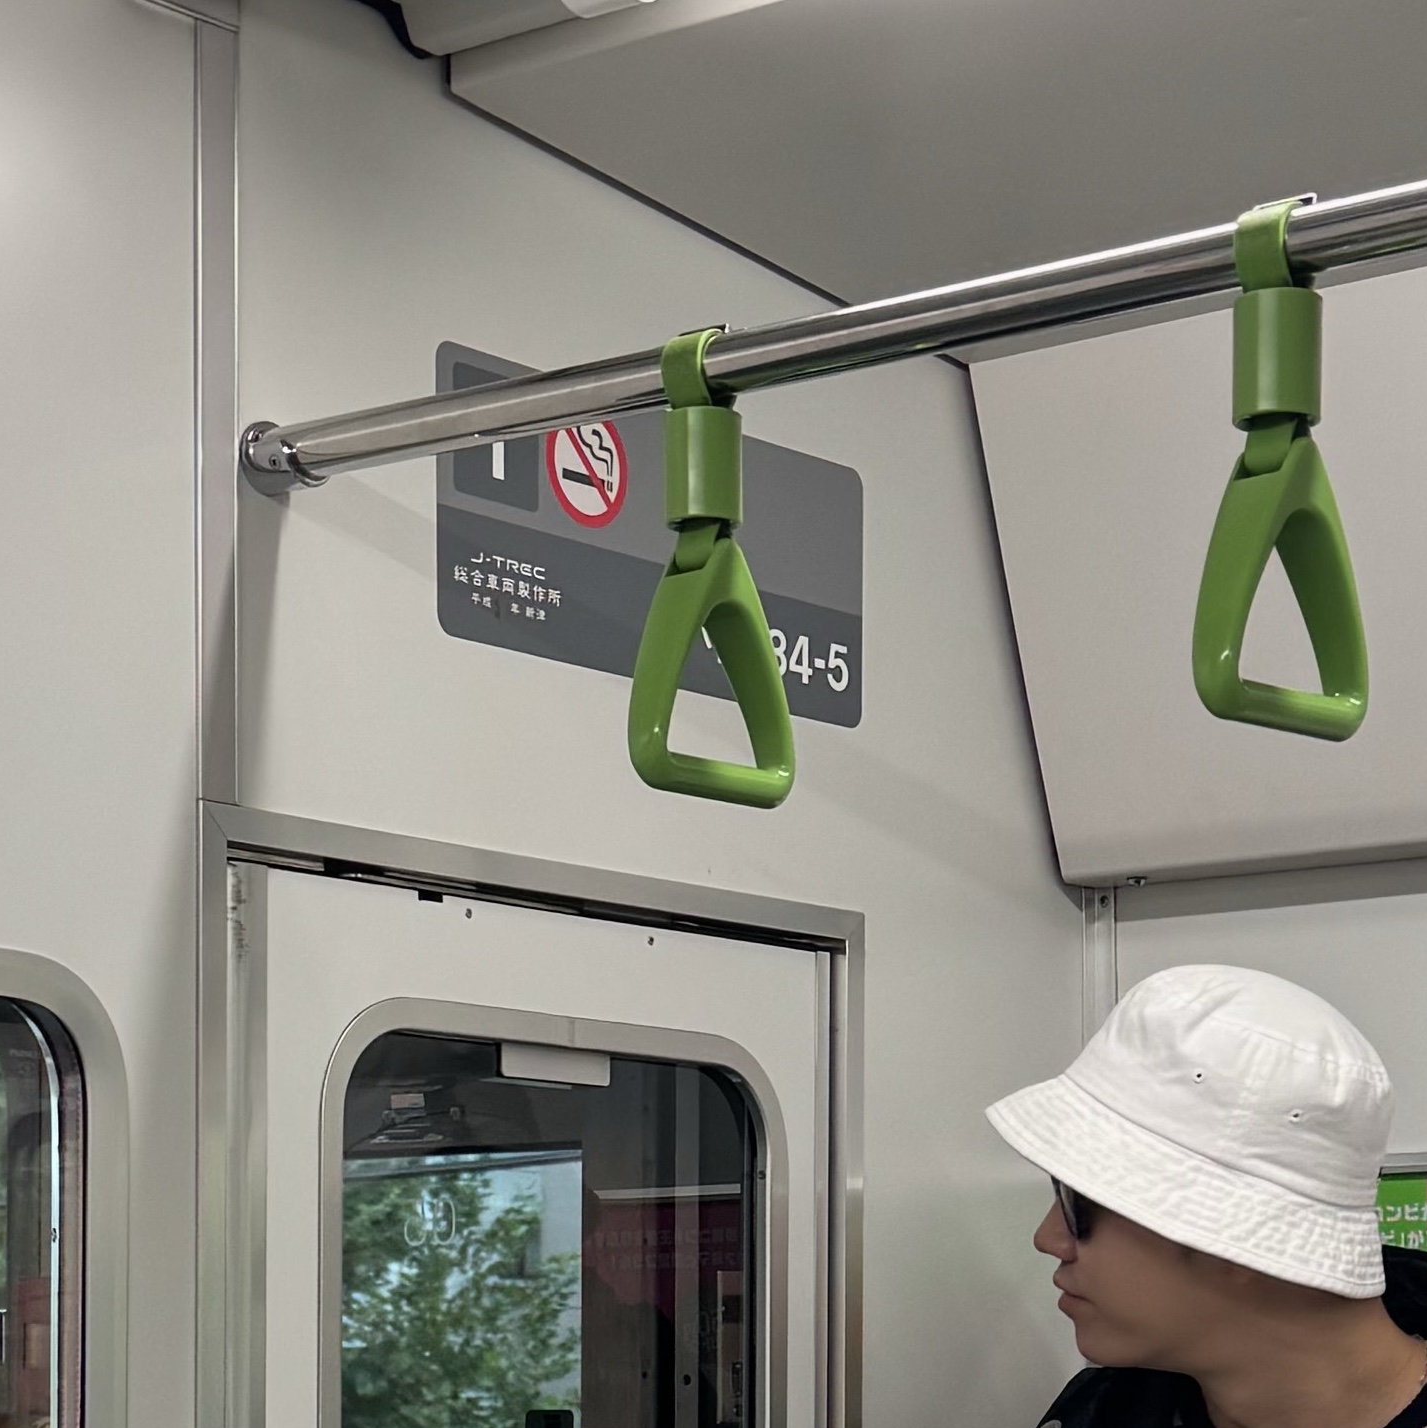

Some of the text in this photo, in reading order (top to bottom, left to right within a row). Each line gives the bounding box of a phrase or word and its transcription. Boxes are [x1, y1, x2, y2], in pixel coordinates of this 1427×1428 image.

[470, 552, 546, 580] J-TREC
[453, 564, 562, 607] 総合車両製作所
